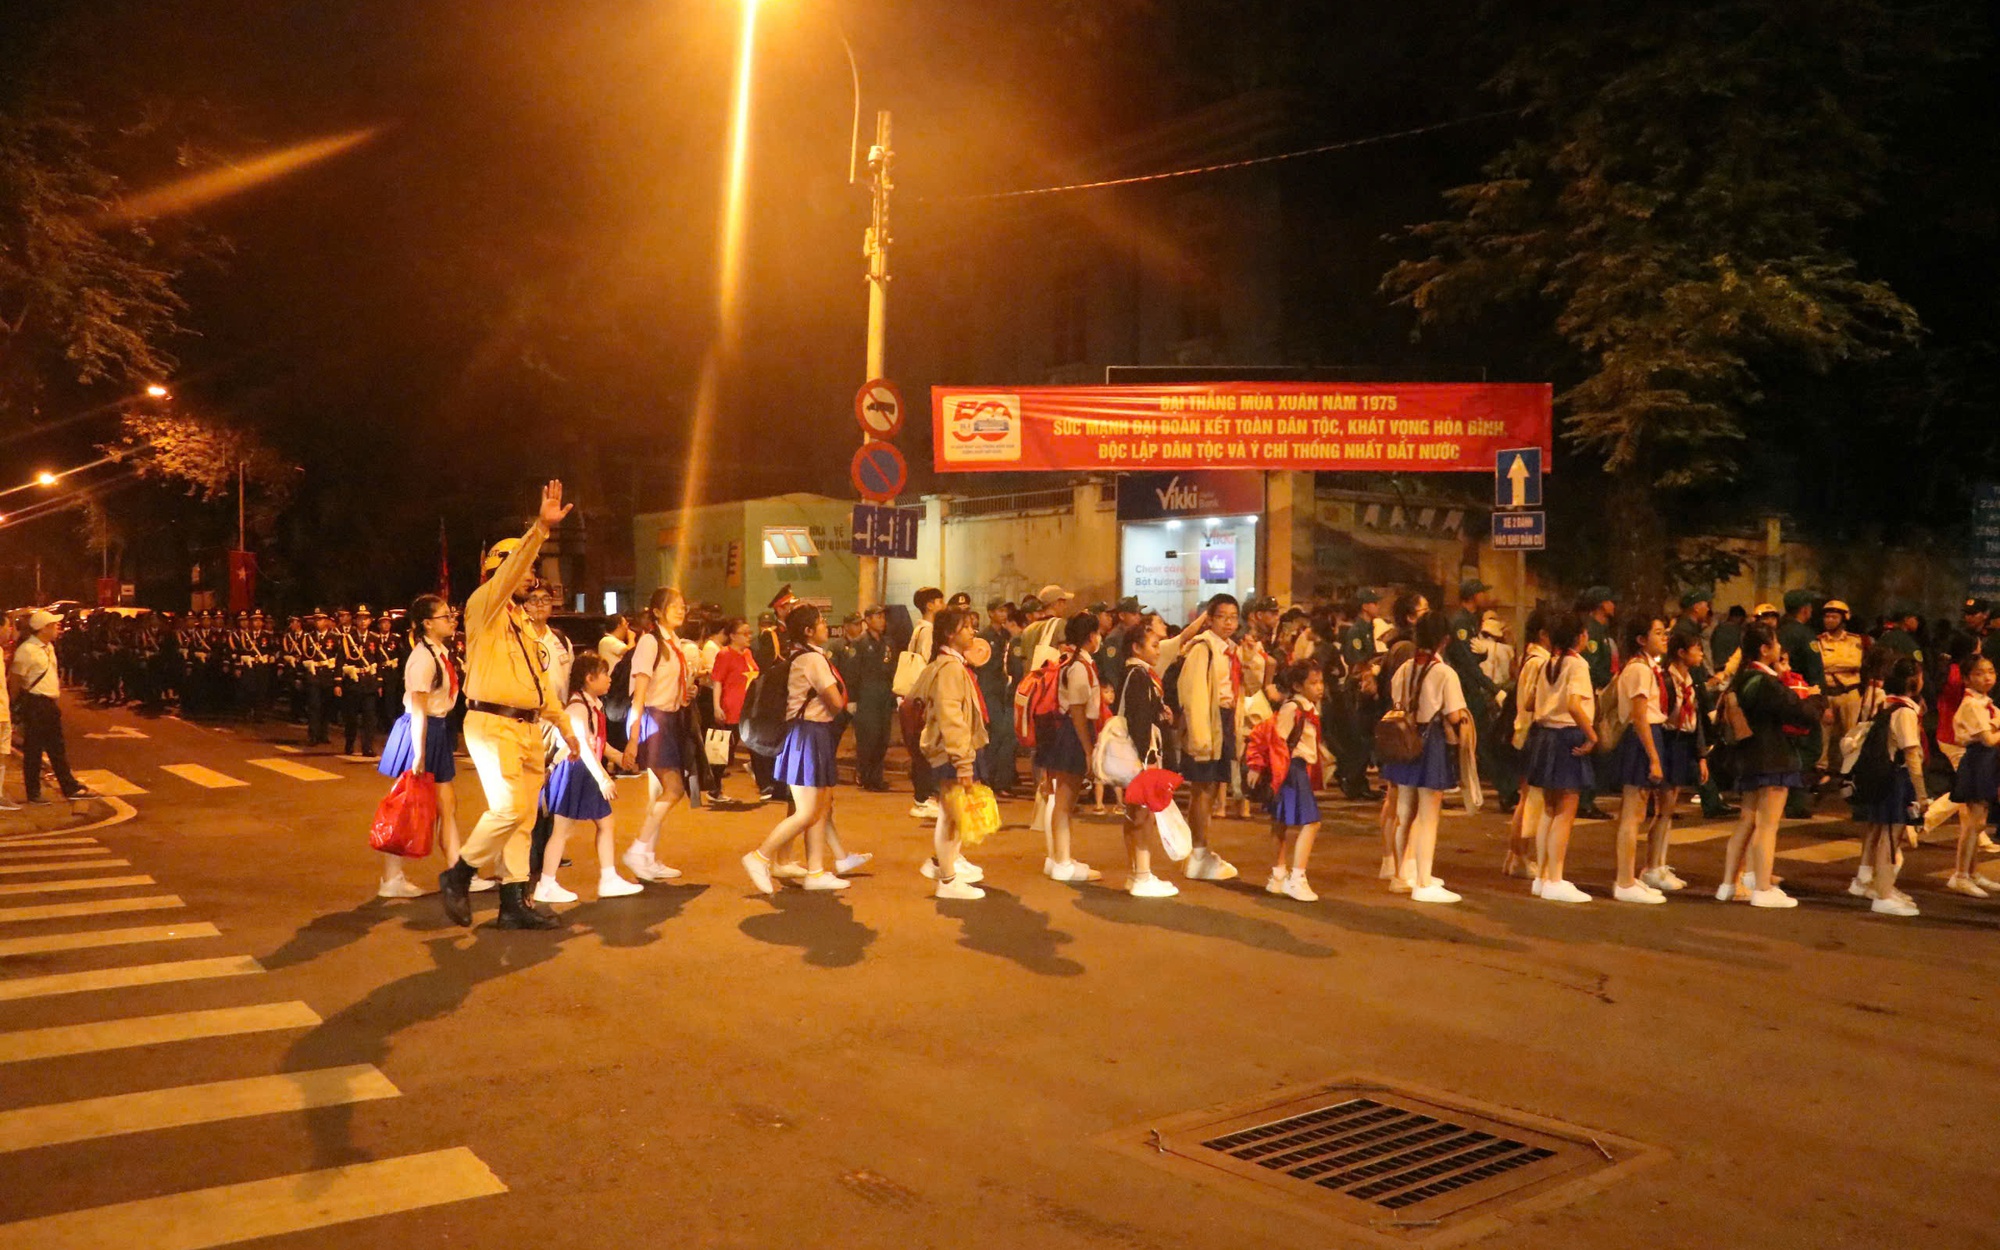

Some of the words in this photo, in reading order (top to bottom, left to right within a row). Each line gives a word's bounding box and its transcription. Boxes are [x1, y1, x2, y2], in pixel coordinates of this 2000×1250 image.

[1240, 391, 1274, 411] MÙA
[1278, 392, 1318, 411] XUÂN
[1322, 392, 1357, 411] NĂM
[1362, 395, 1397, 411] 1975
[1086, 419, 1129, 439] MẠNH
[1132, 419, 1157, 438] ĐẠI
[1204, 414, 1231, 435] KẾT
[1235, 416, 1273, 435] TOÀN
[1277, 416, 1307, 435] DÂN
[1312, 416, 1343, 438] TỘC,
[1348, 416, 1386, 435] KHÁT
[1389, 419, 1430, 438] VỌNG
[1099, 440, 1127, 462] ĐỘC
[1131, 440, 1158, 462] LẬP
[1162, 440, 1192, 459] DÂN
[1196, 440, 1224, 462] TỘC
[1228, 440, 1246, 459] VÀ
[1251, 440, 1260, 459] Ý
[1263, 440, 1288, 459] CHÍ
[1292, 438, 1341, 459] THỐNG
[1344, 438, 1386, 459] NHẤT
[1387, 438, 1415, 459] ĐẤT
[1419, 441, 1460, 459] NƯỚC
[1155, 475, 1198, 510] Vikki
